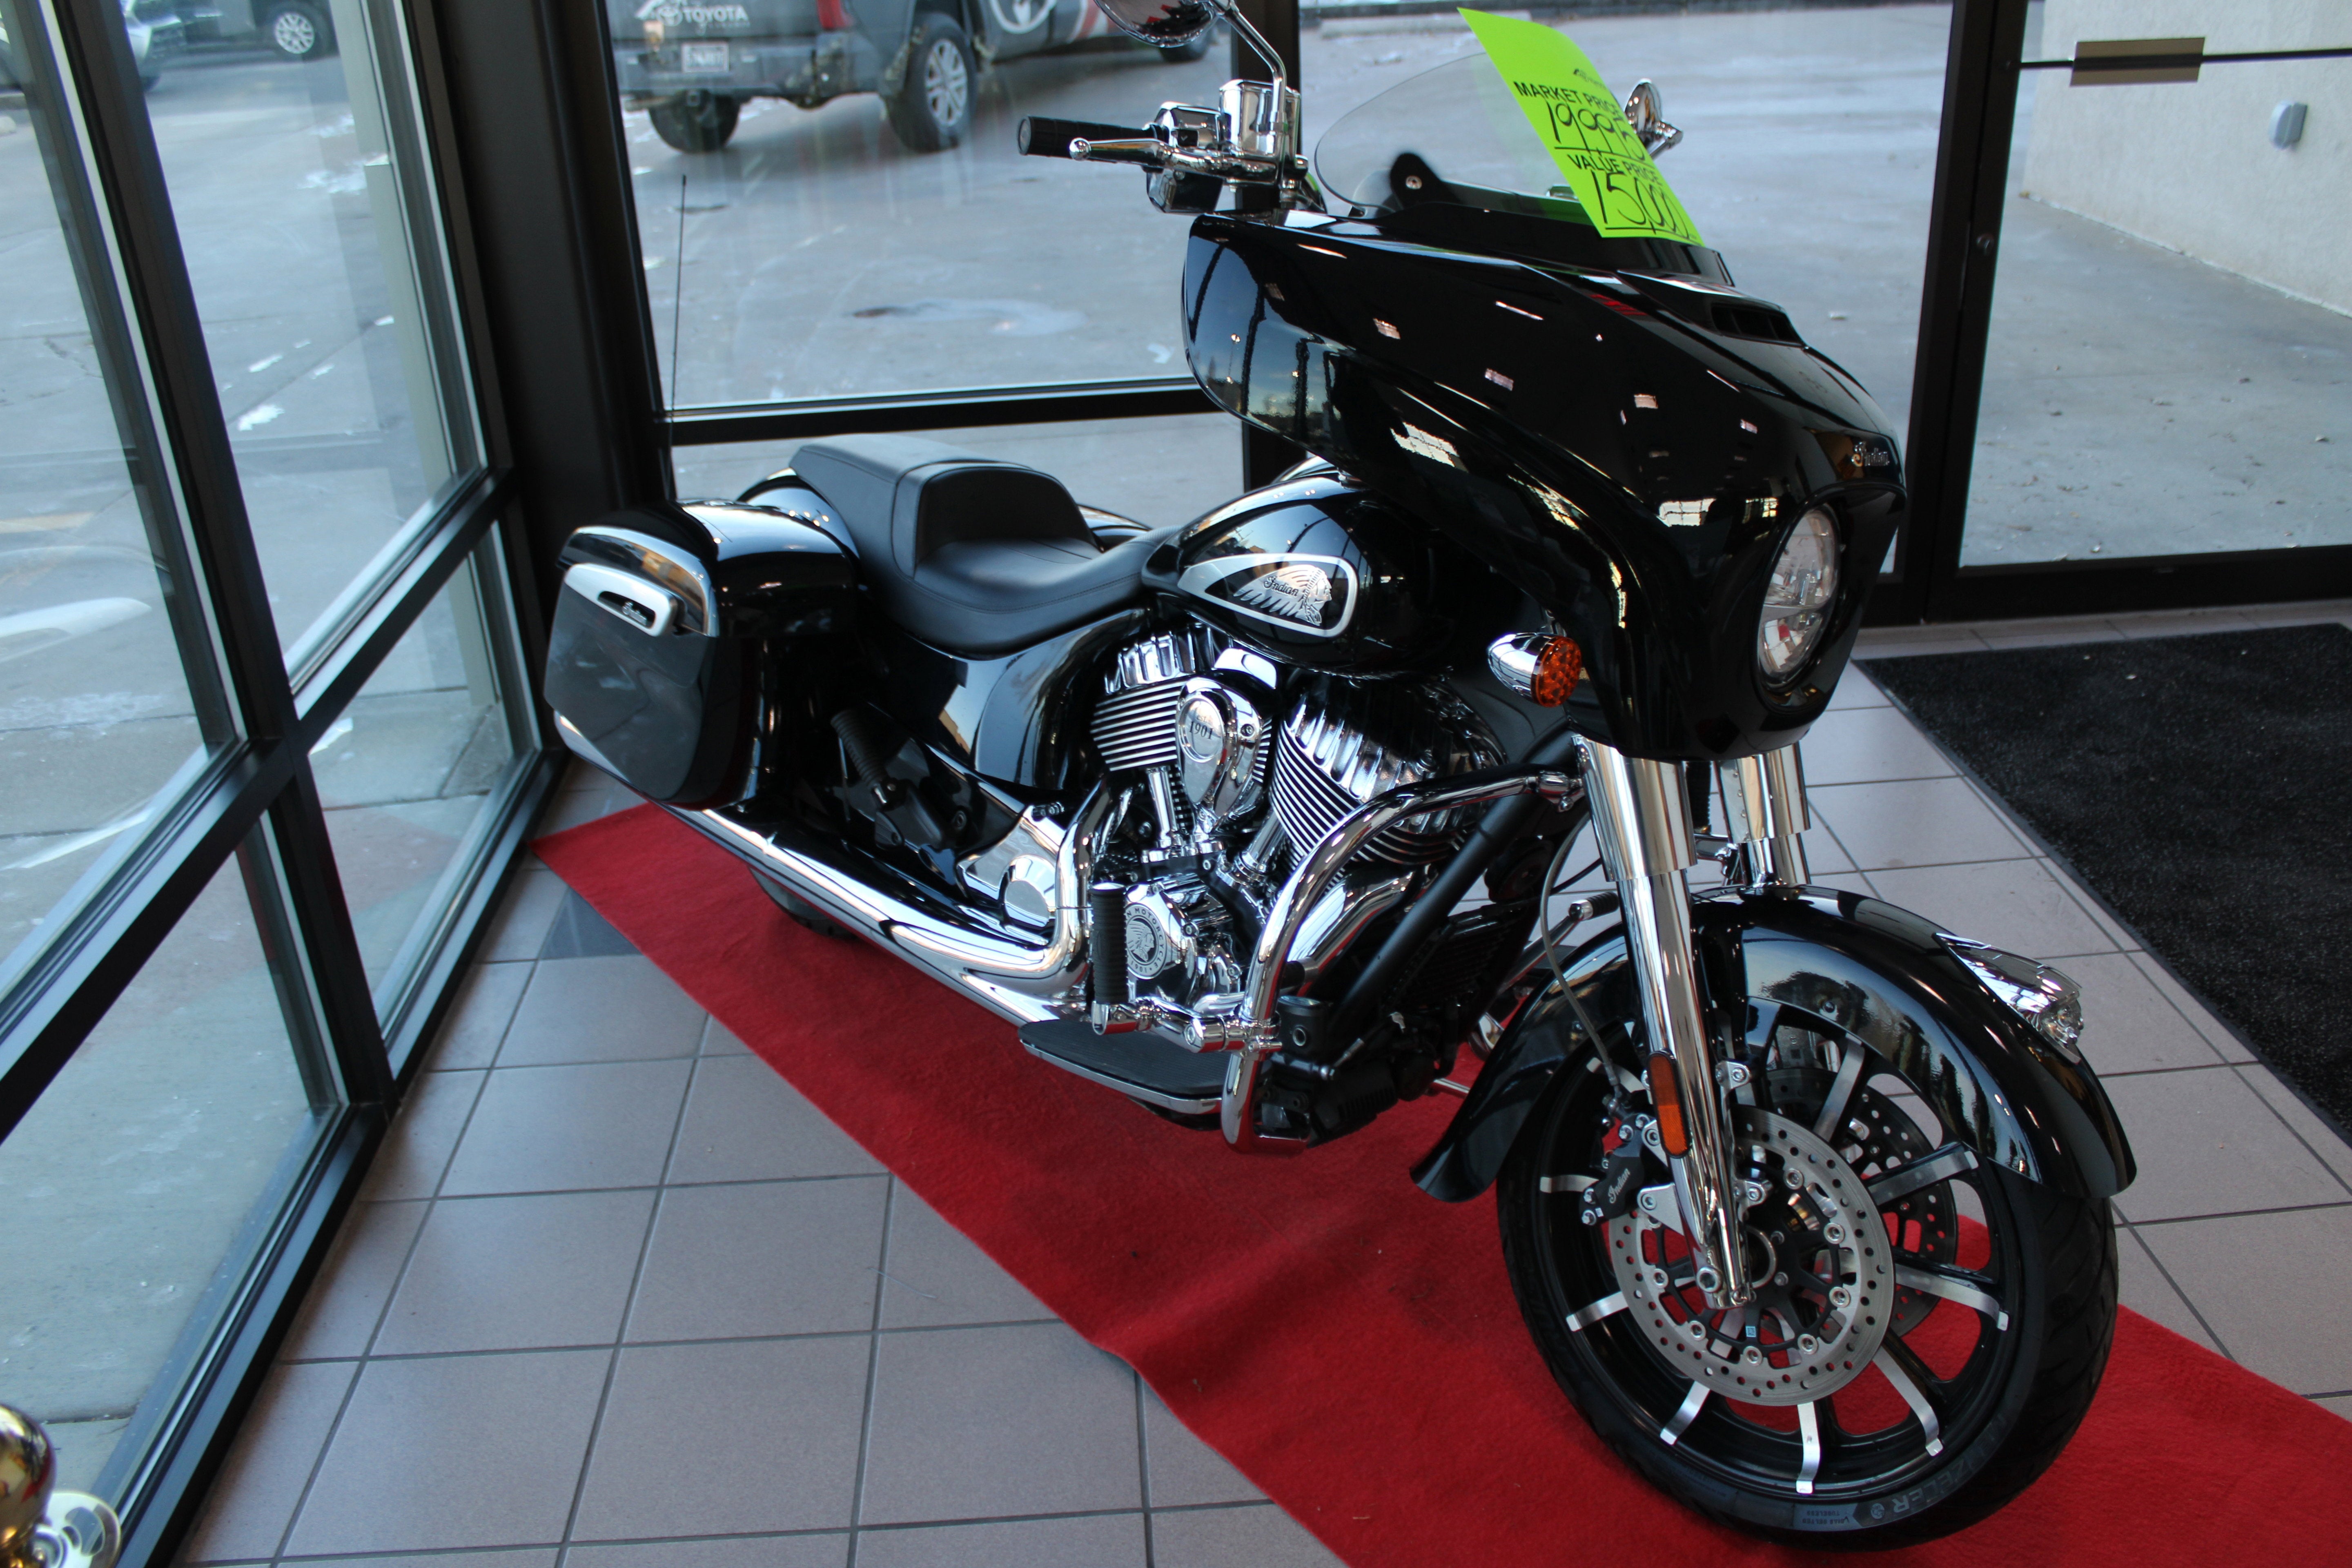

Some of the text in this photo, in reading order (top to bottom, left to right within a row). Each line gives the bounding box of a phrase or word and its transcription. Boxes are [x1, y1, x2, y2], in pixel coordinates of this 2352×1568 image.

[683, 5, 749, 22] TOYOTA
[1514, 82, 1621, 117] MARKET PRICE
[1568, 154, 1662, 186] VALUE PRICE
[1263, 576, 1299, 597] Indian
[1189, 722, 1213, 739] 1901
[1135, 908, 1164, 967] MOTORCYCLE
[1608, 1168, 1630, 1203] Indian
